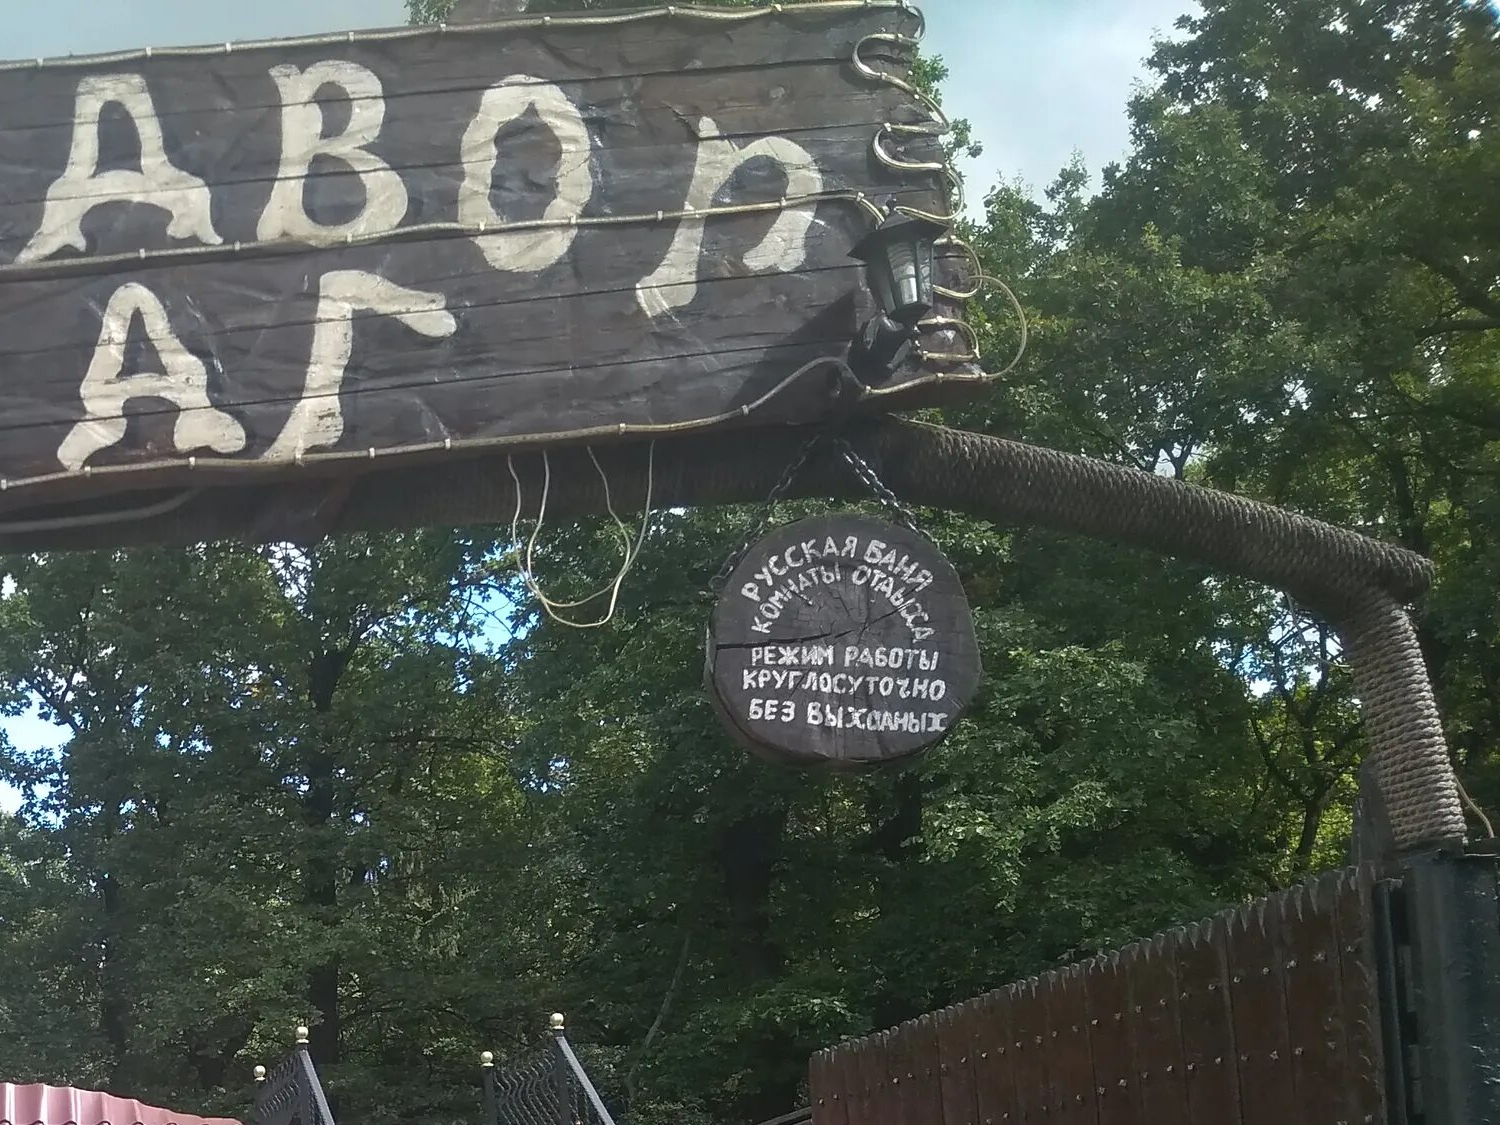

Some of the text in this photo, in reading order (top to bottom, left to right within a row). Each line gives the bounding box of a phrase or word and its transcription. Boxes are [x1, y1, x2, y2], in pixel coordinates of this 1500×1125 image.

[13, 59, 824, 317] ДВОР
[741, 536, 933, 602] РУССКАЯ БАНЯ
[751, 562, 841, 634] КОМНАТЫ
[751, 645, 939, 671] РЕЖИМ РАБОТЫ
[742, 669, 946, 701] КРУГЛОСУТОЧНО
[748, 698, 796, 722] БЕЗ
